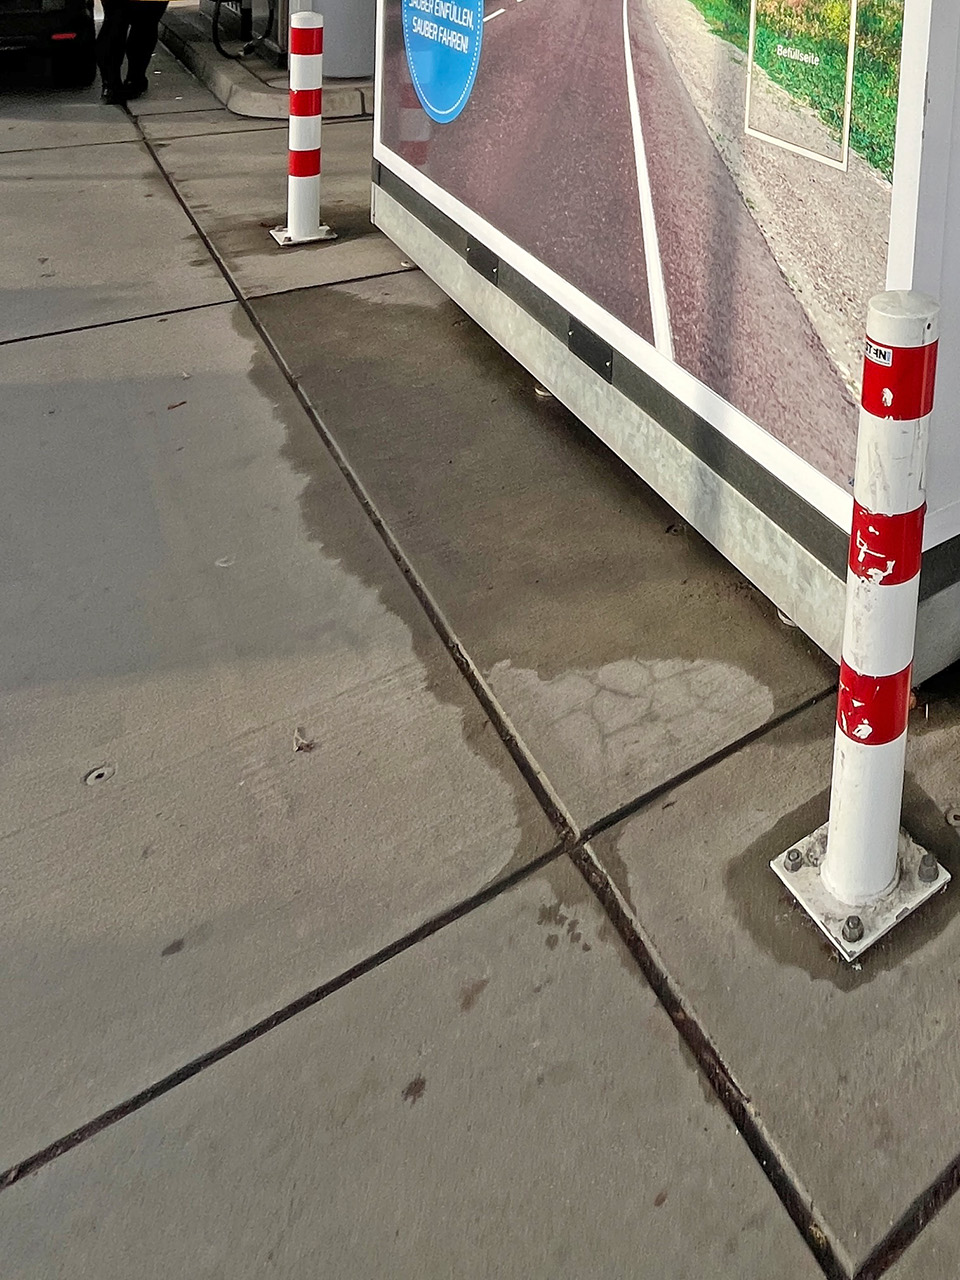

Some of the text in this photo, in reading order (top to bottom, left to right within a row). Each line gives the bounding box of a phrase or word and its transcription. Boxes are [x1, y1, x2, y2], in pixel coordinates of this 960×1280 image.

[434, 0, 474, 31] EINFÜLLEN,
[412, 16, 469, 54] SAUBER FAHREN!
[776, 44, 820, 66] Befüllseite
